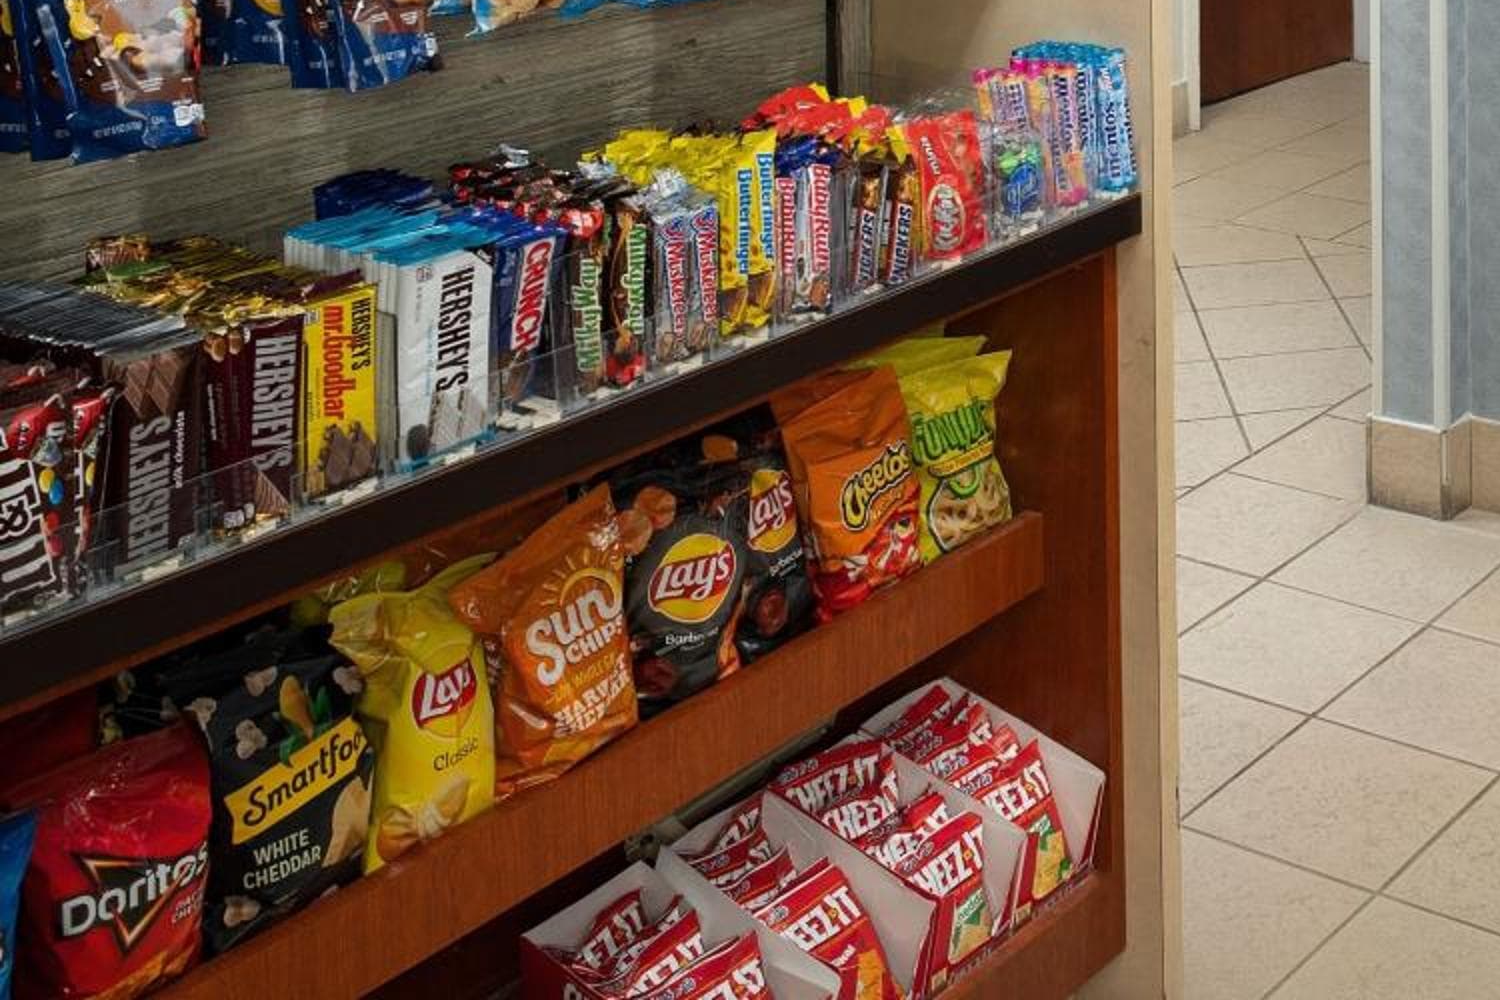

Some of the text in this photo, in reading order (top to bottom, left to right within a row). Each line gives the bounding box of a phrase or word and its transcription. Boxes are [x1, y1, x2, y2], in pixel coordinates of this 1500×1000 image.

[1104, 102, 1121, 178] mentos
[889, 205, 913, 282] SNICKERS
[350, 297, 371, 370] HERSHEY'S
[435, 265, 475, 392] HERSHEY'S
[511, 240, 553, 351] CRUNCH
[251, 334, 298, 470] HERSHEY'S
[842, 443, 910, 532] Cheetos
[652, 546, 733, 601] Lay's
[525, 588, 622, 687] Sun
[243, 731, 365, 827] Smartfoo
[433, 737, 479, 771] Classic
[243, 844, 322, 890] CHEDDAR
[252, 827, 310, 866] WHITE
[62, 841, 209, 936] Doritos
